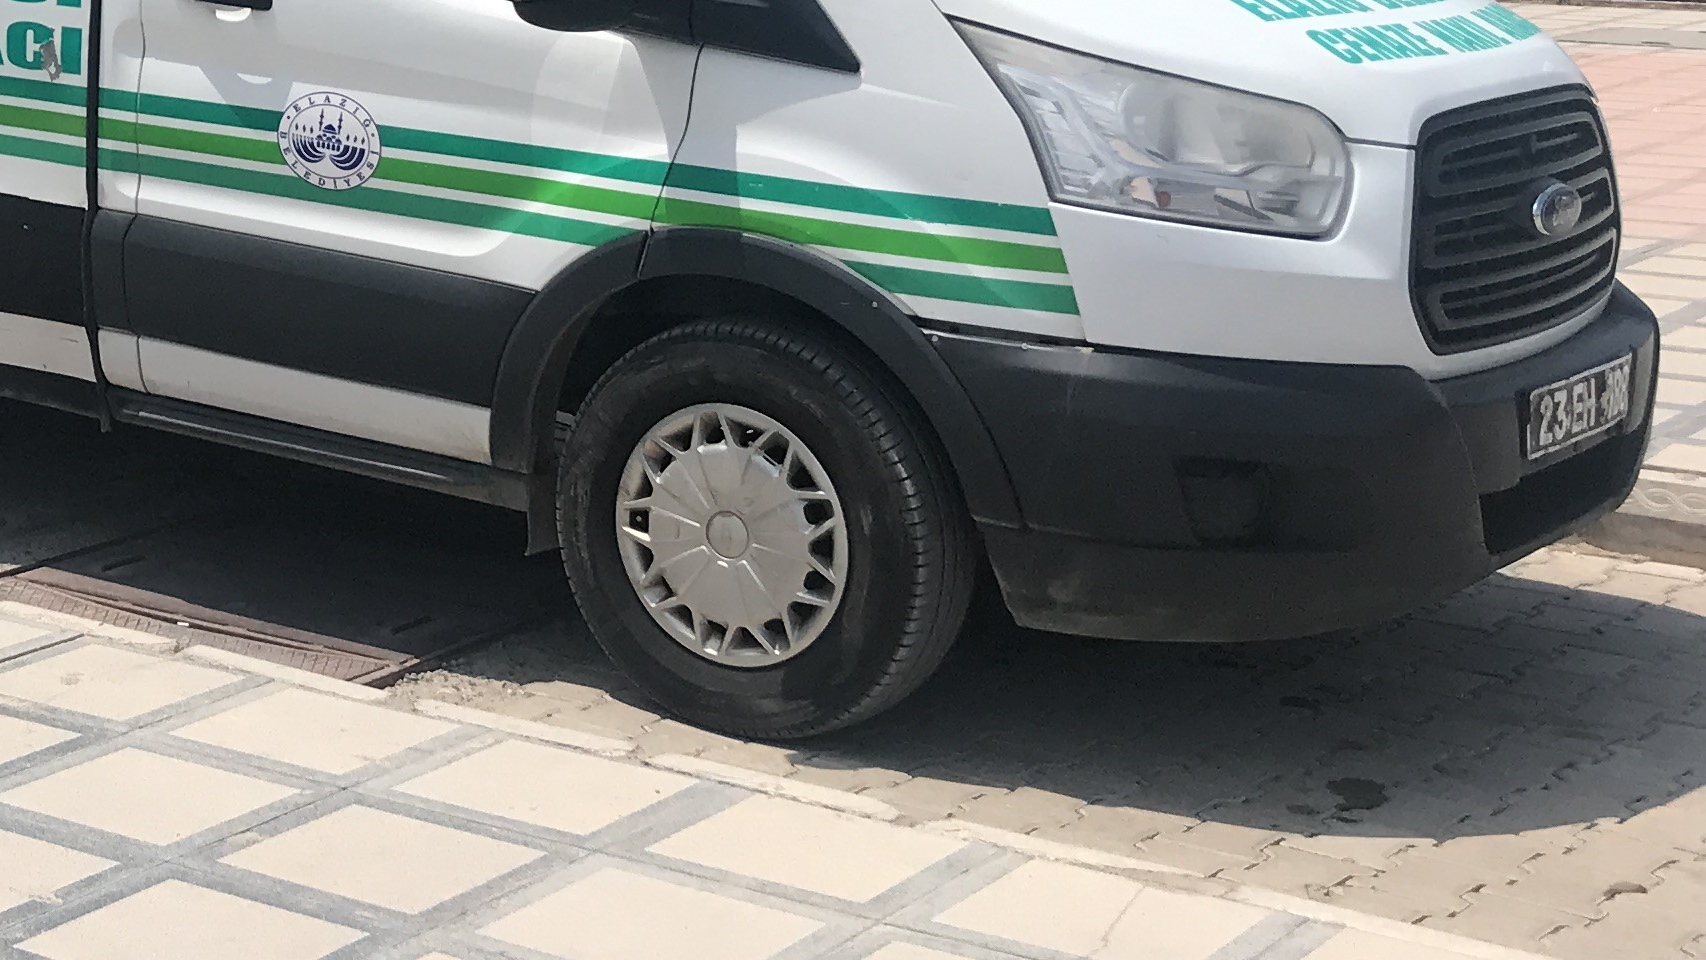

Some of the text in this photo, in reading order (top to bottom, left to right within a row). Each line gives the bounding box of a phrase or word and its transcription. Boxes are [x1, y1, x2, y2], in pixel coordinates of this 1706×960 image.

[1305, 23, 1450, 65] CENAZE
[1539, 389, 1568, 446] 23
[1571, 377, 1596, 434] EH
